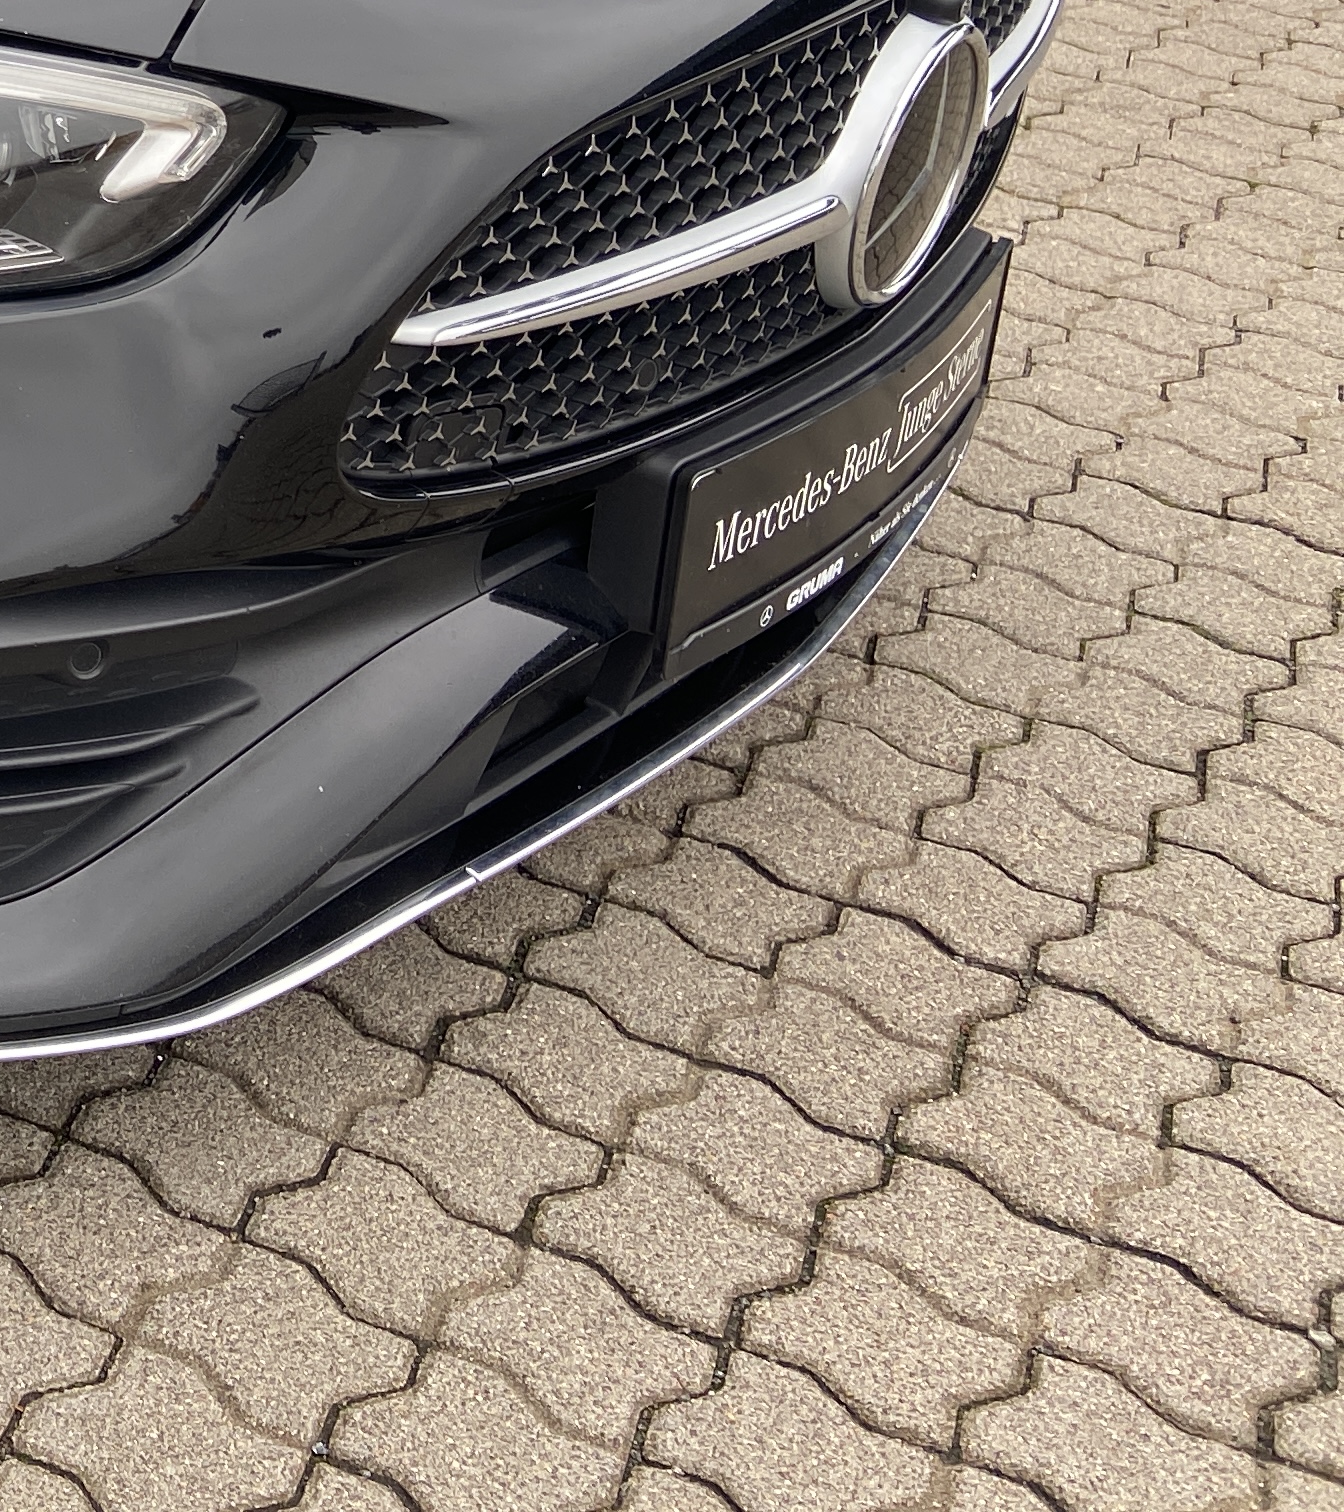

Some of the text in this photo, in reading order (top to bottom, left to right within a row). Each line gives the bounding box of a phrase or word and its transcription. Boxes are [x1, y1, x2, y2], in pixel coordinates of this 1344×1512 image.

[707, 427, 892, 571] Mercedes-Benz
[892, 380, 944, 458] Junge
[786, 556, 844, 611] GRUMA
